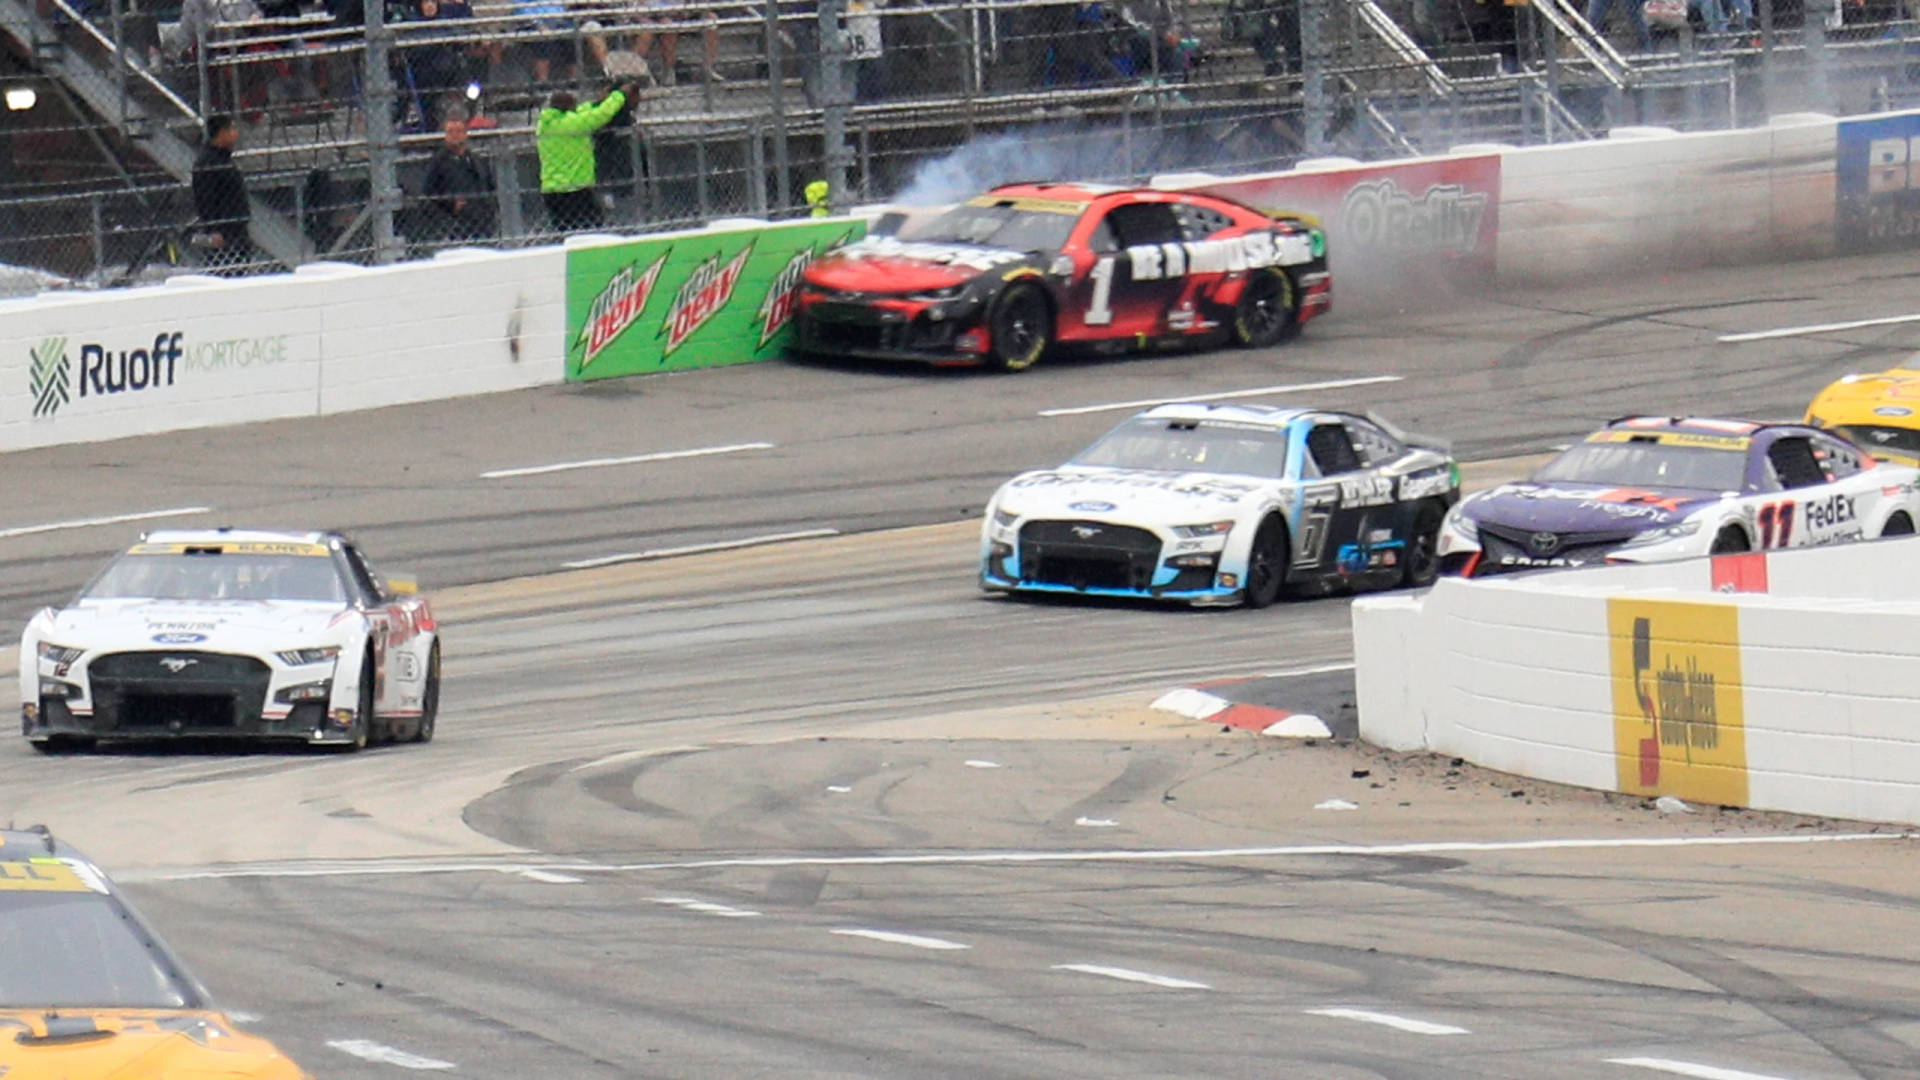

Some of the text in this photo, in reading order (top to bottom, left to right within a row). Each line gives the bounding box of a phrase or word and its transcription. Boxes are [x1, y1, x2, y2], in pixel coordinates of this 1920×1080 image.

[1083, 256, 1115, 325] 1
[79, 331, 289, 397] Ruoff MORTGAGE
[1758, 500, 1795, 549] 11
[1805, 494, 1858, 532] FedEx
